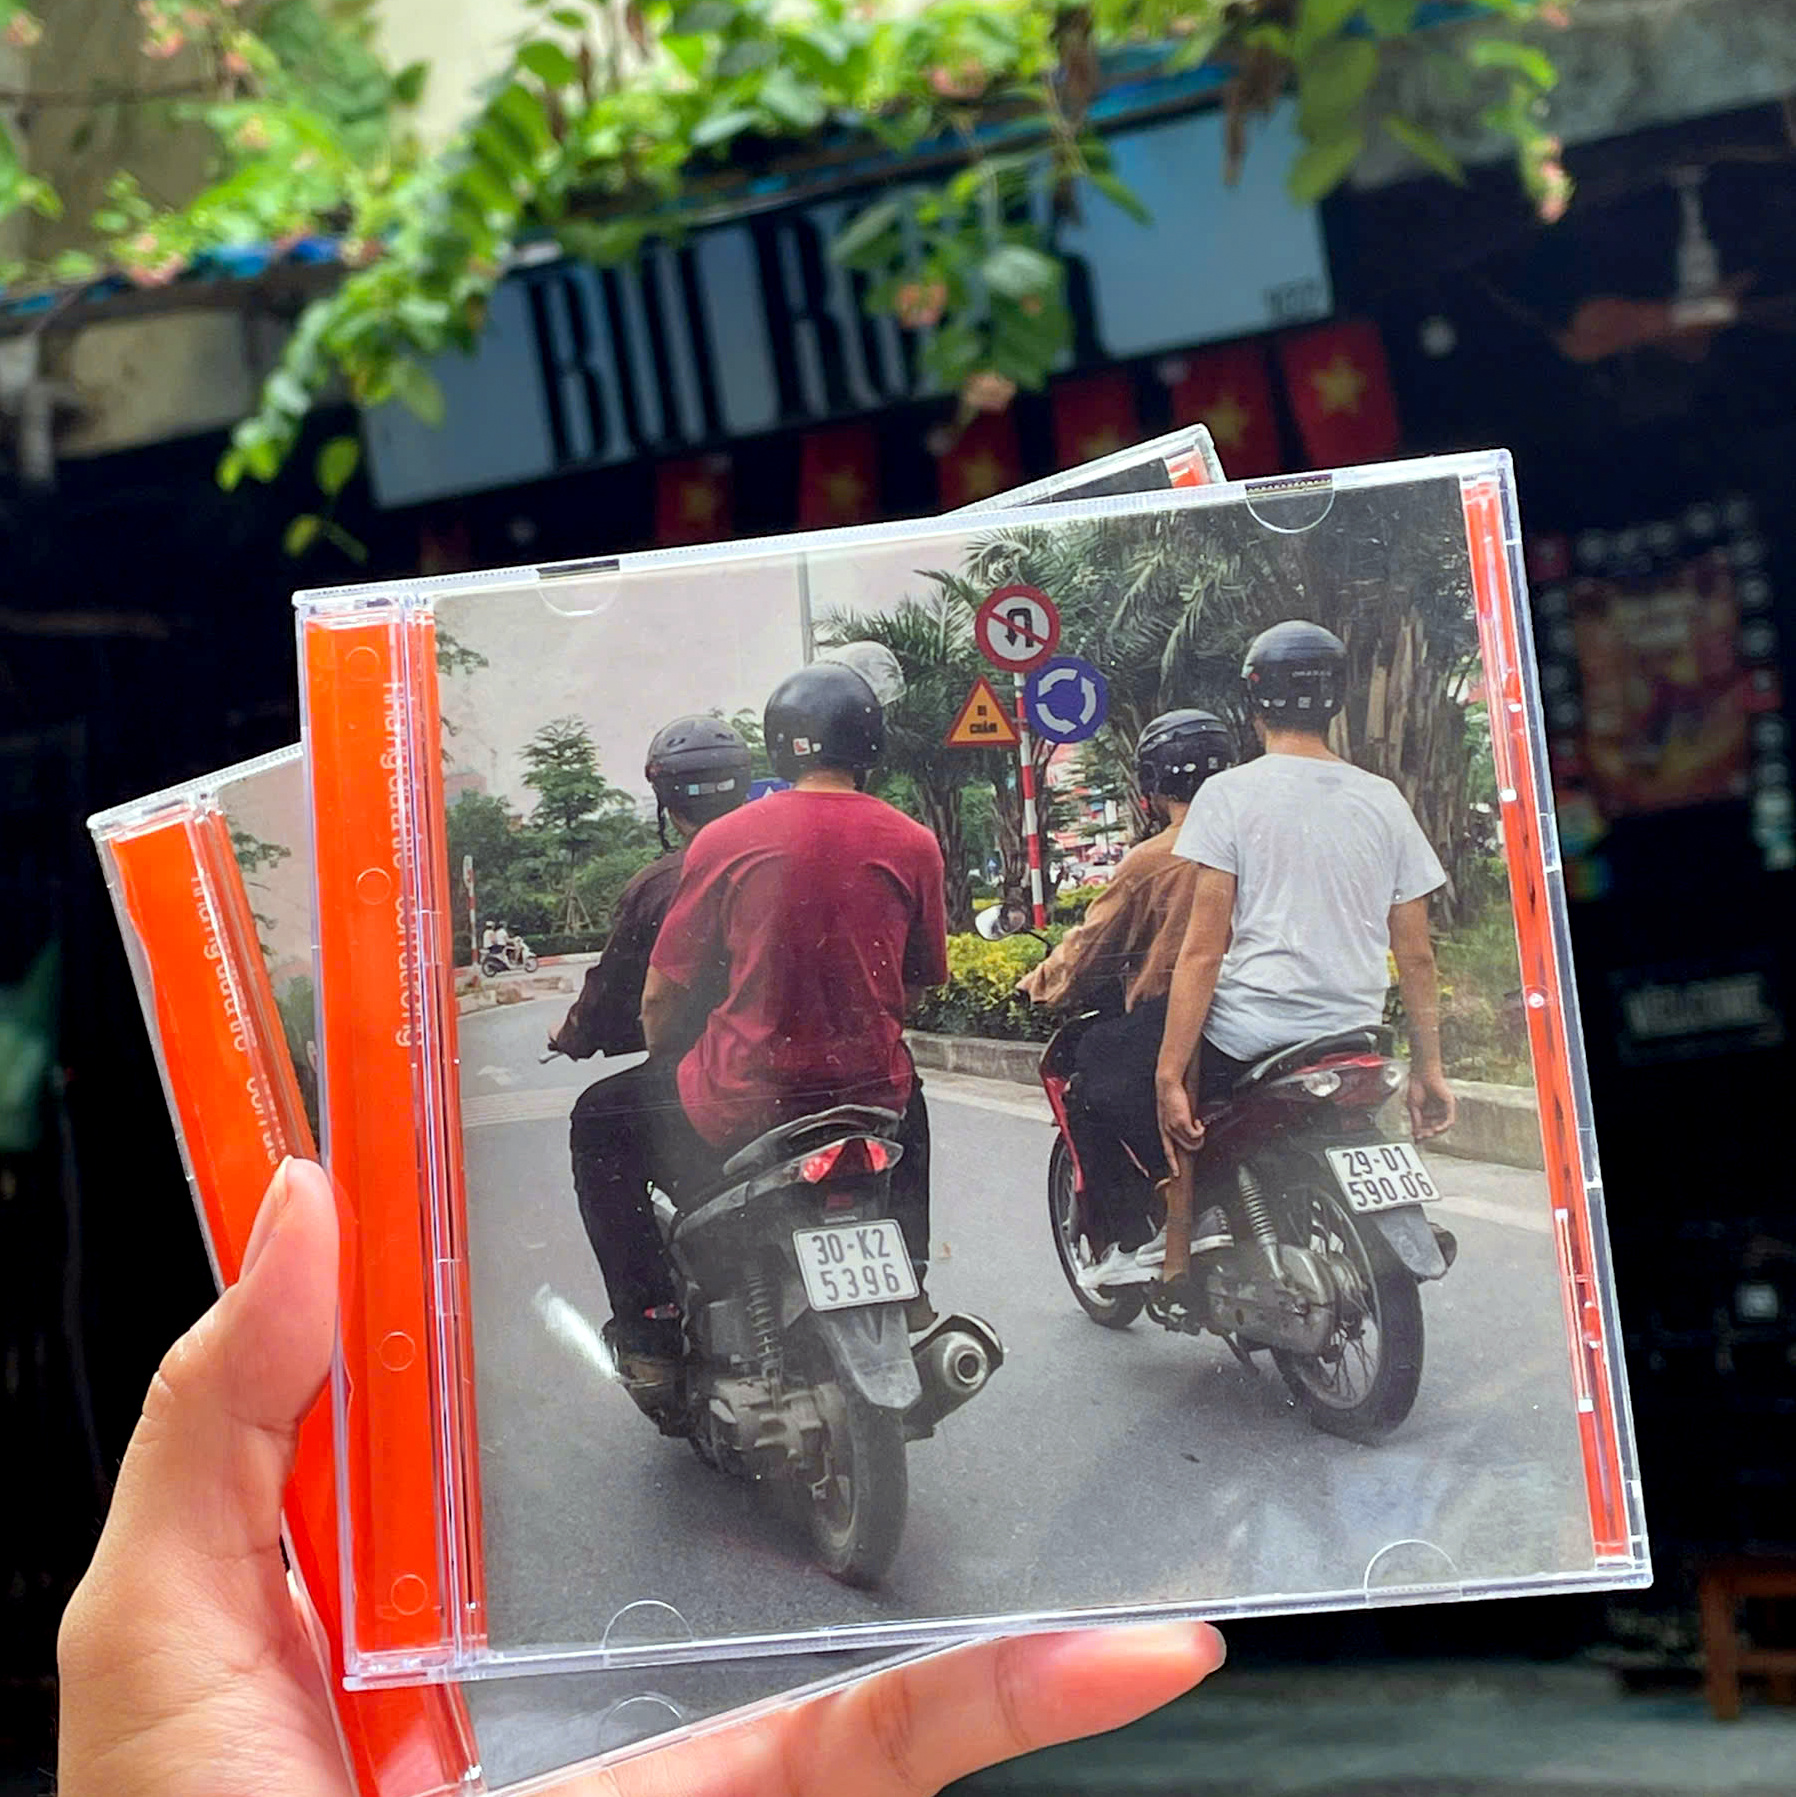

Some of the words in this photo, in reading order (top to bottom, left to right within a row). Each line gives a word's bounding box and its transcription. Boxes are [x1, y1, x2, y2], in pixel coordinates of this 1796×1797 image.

[1347, 1172, 1433, 1207] 590.06
[811, 1228, 891, 1266] 30-K2
[820, 1262, 900, 1302] 5396
